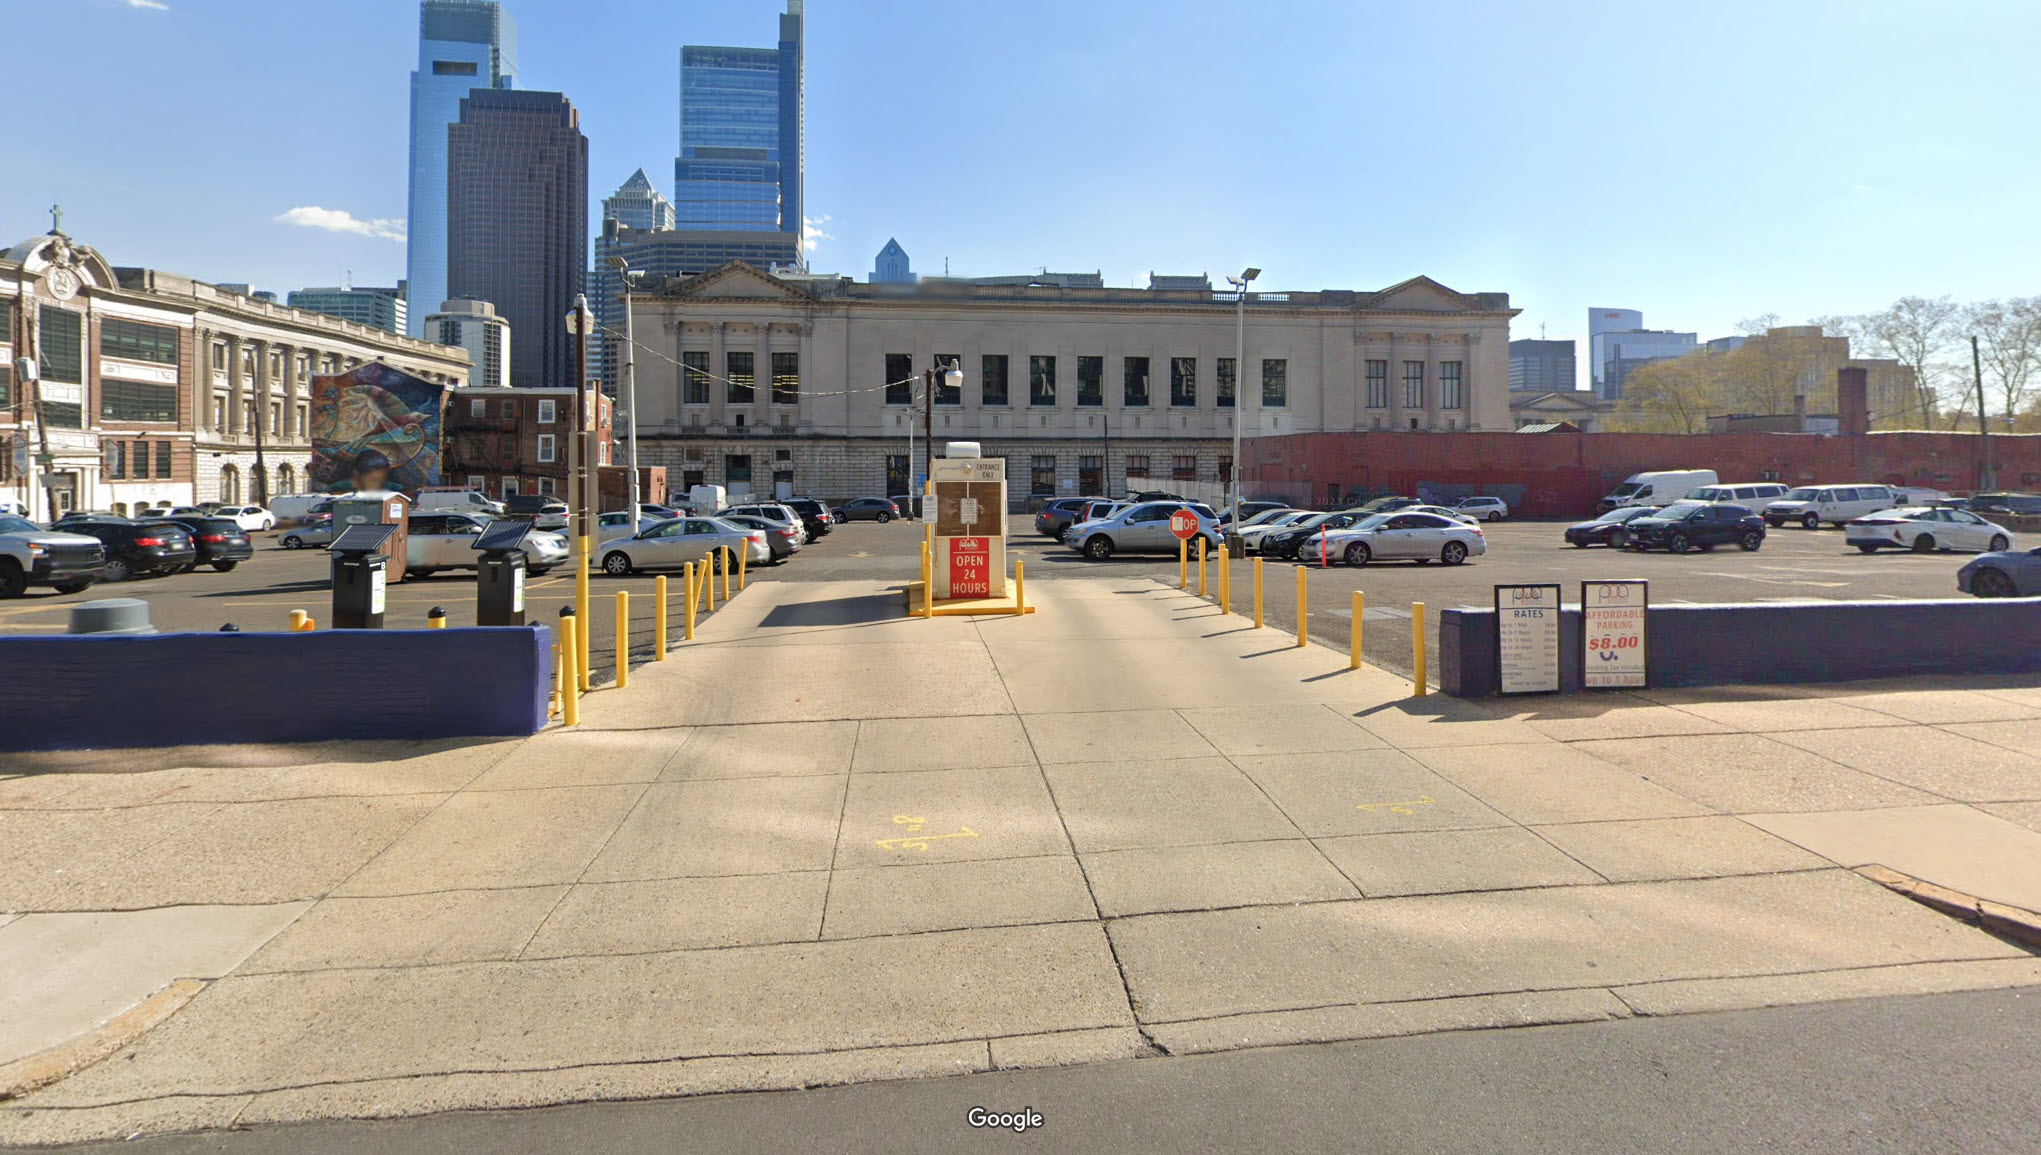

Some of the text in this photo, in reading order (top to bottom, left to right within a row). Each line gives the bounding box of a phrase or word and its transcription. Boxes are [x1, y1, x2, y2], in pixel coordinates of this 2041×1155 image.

[976, 463, 1001, 471] ENTRANCE
[982, 471, 994, 479] ONLY
[956, 556, 984, 567] OPEN
[963, 569, 976, 580] 24
[952, 583, 987, 595] HOURS
[1514, 609, 1544, 619] RATES
[1586, 609, 1645, 620] AFFORDABLE
[1597, 620, 1633, 630] PARKING
[1588, 636, 1639, 651] $8.00
[1602, 675, 1612, 684] to
[1623, 674, 1644, 684] hour
